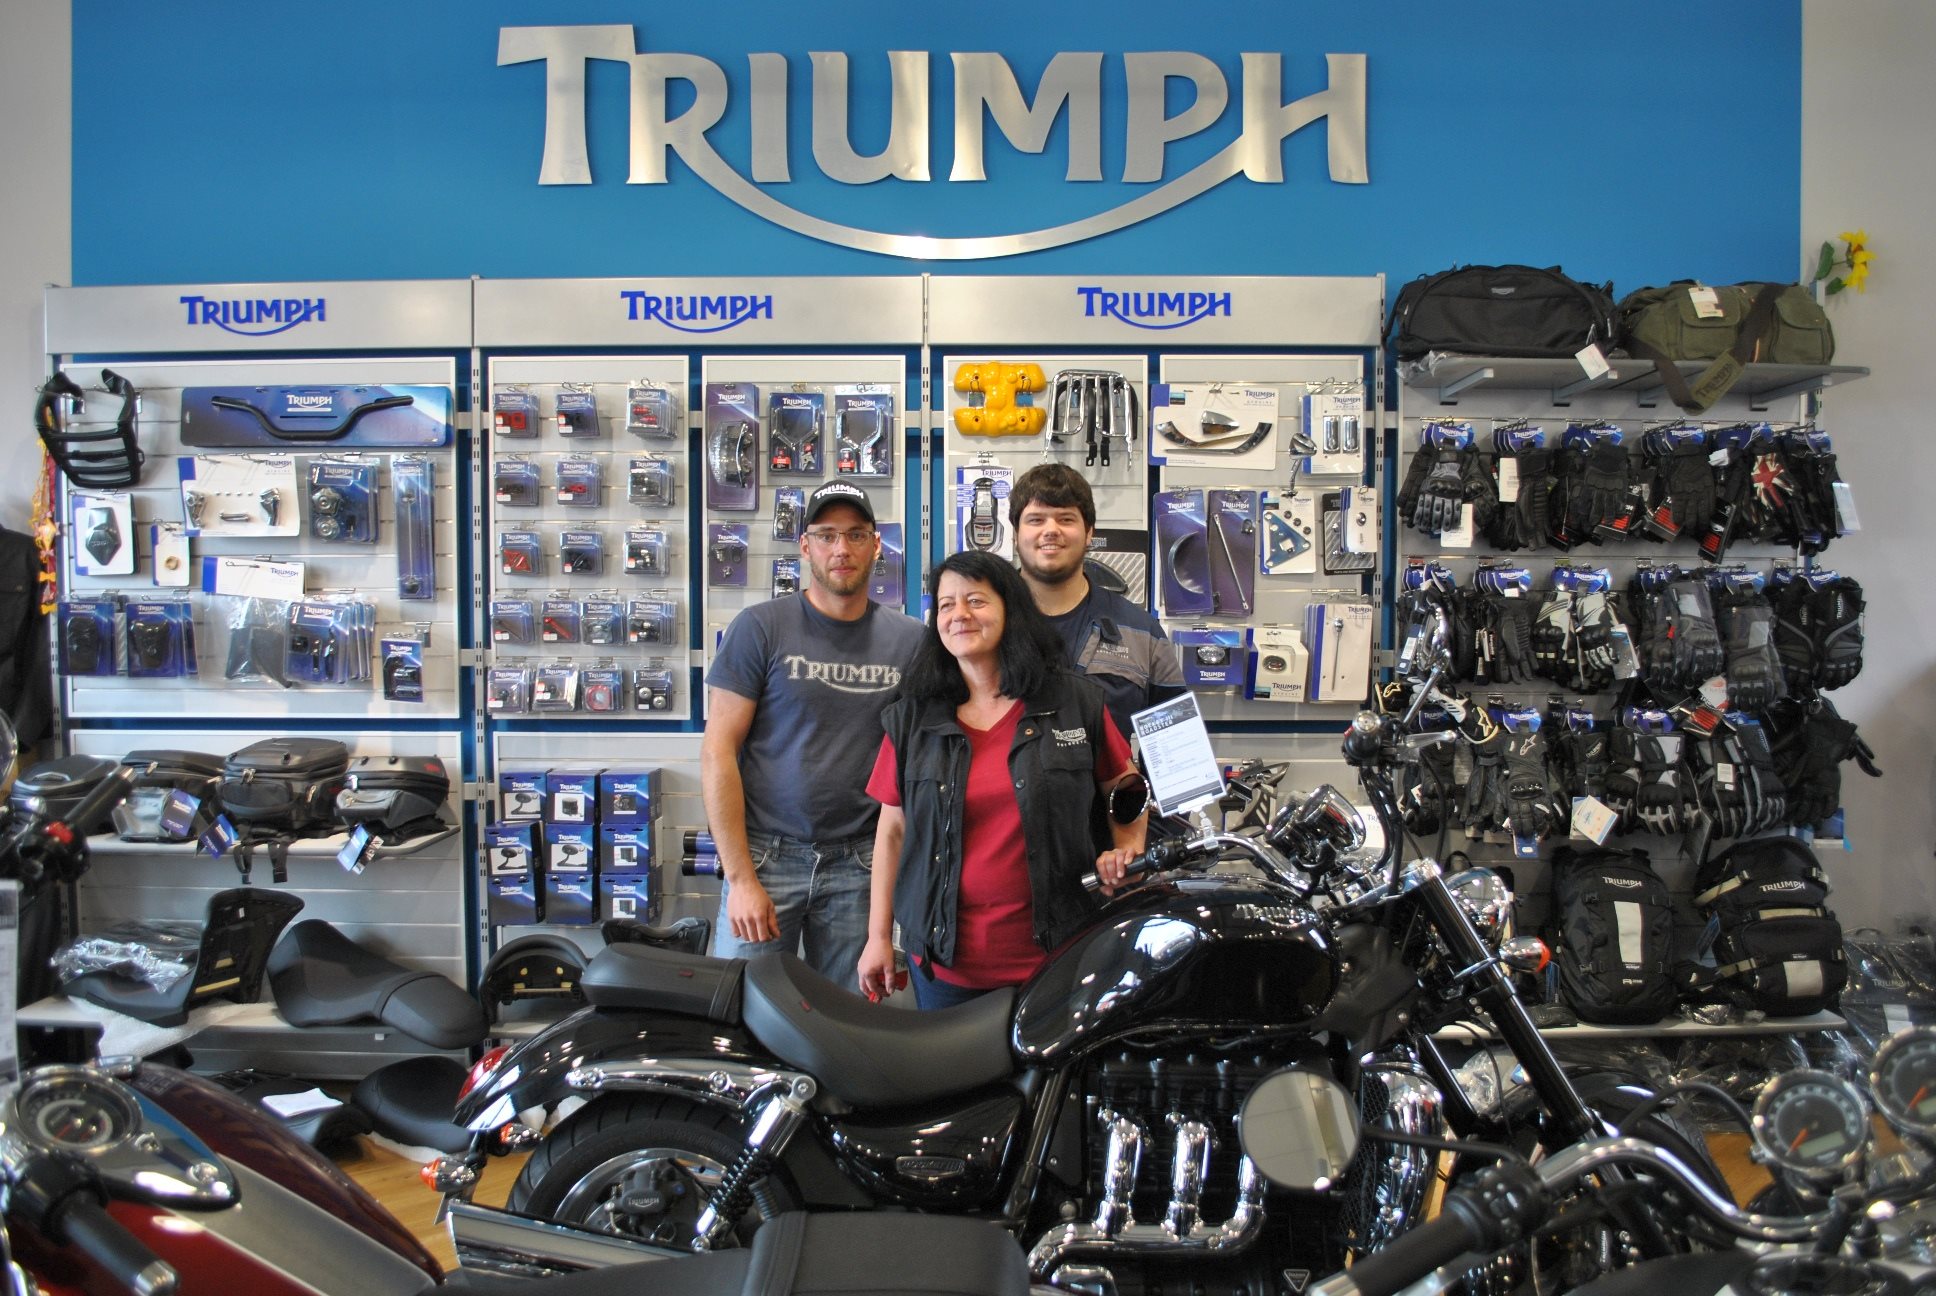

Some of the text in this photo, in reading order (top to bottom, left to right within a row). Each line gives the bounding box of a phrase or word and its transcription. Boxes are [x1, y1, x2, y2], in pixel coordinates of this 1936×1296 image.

[497, 24, 1369, 260] TRIUMPH
[621, 290, 774, 334] TRIUMPH
[1077, 286, 1232, 330] TRIUMPH
[180, 295, 326, 336] TRIUMPH
[718, 393, 745, 401] TRIUMPH
[1244, 389, 1275, 400] TRIUMPH
[287, 394, 333, 408] TRIUMPH
[782, 397, 812, 407] TRIUMPH
[847, 399, 876, 408] TRIUMPH
[264, 459, 292, 469] TRIUMPH
[981, 469, 1012, 479] TRIUMPH
[814, 484, 864, 500] TRIUMPH
[1167, 501, 1195, 509] TRIUMPH
[271, 567, 299, 578] TRIUMPH
[1347, 606, 1372, 614] TRIUMPH
[784, 654, 902, 694] TRIUMPH
[1199, 670, 1226, 678] TRIUMPH
[1272, 682, 1302, 692] TRIUMPH
[1602, 876, 1642, 889] TRIUMPH
[1759, 880, 1806, 892] TRIUMPH
[627, 1197, 660, 1208] TRIUMPH
